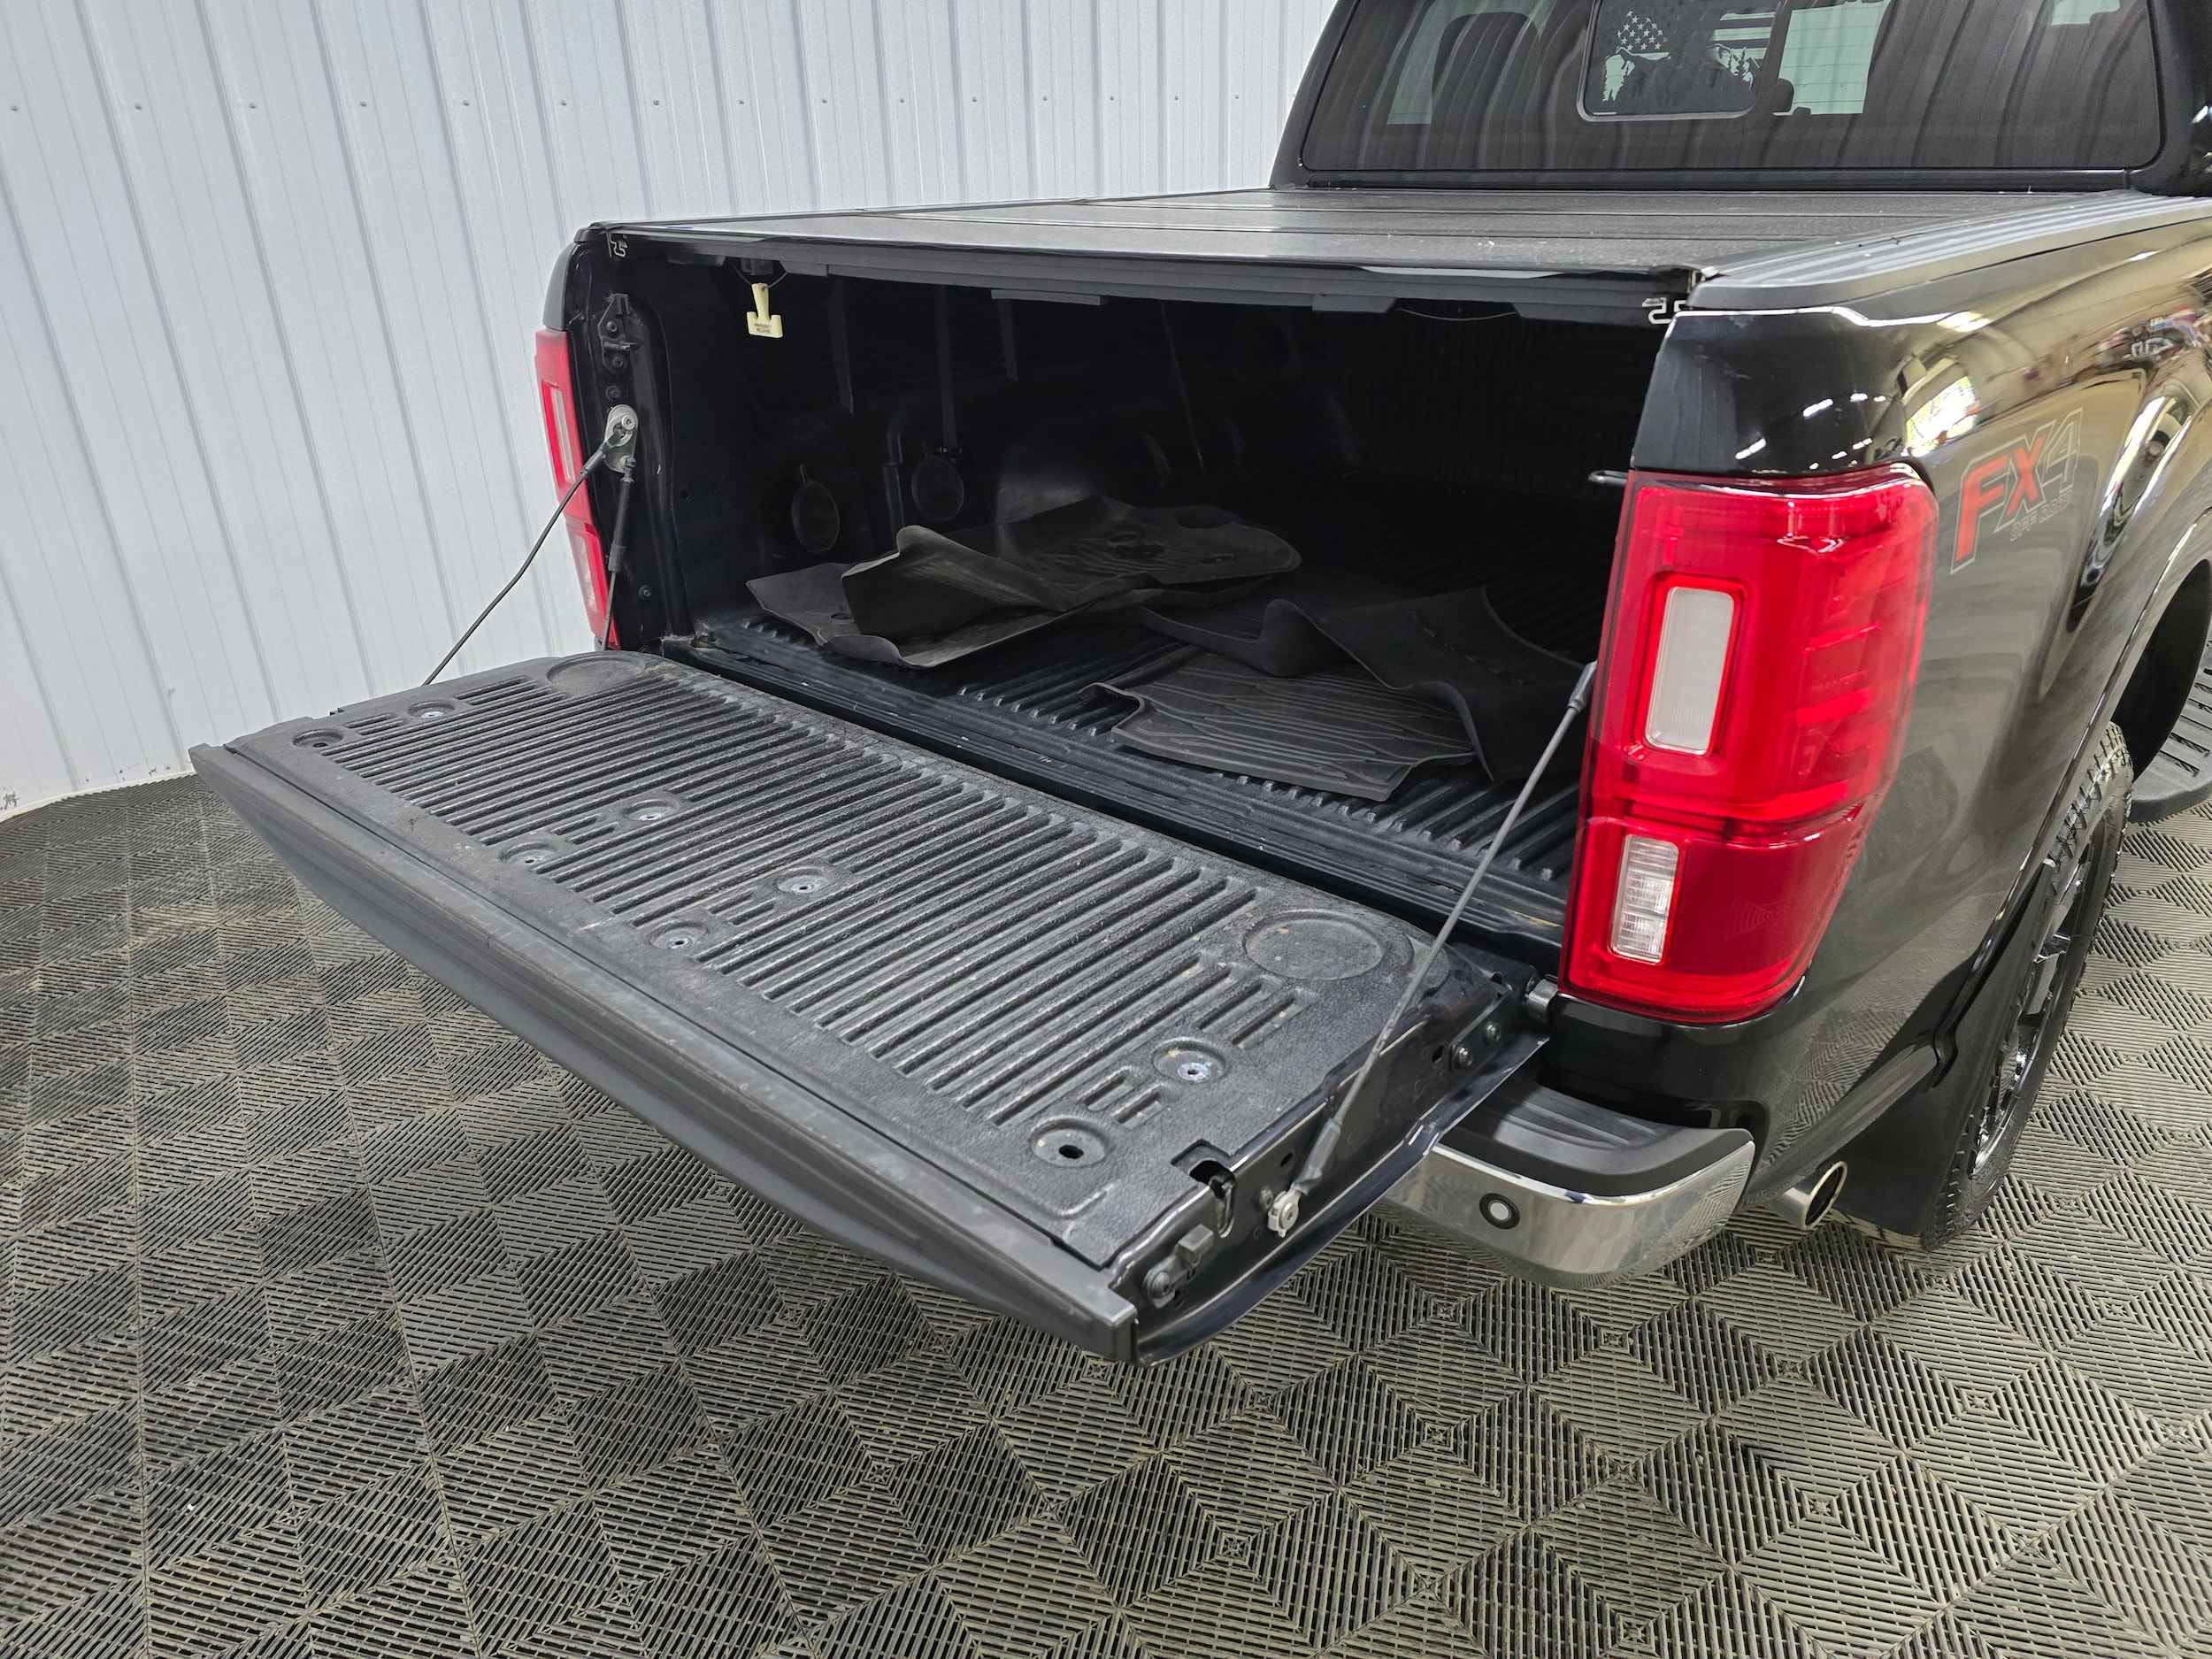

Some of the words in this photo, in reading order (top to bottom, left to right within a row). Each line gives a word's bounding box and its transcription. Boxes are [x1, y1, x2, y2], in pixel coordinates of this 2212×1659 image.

[1950, 406, 2084, 574] FX4
[2009, 510, 2038, 542] OFF
[2039, 488, 2073, 524] ROAD
